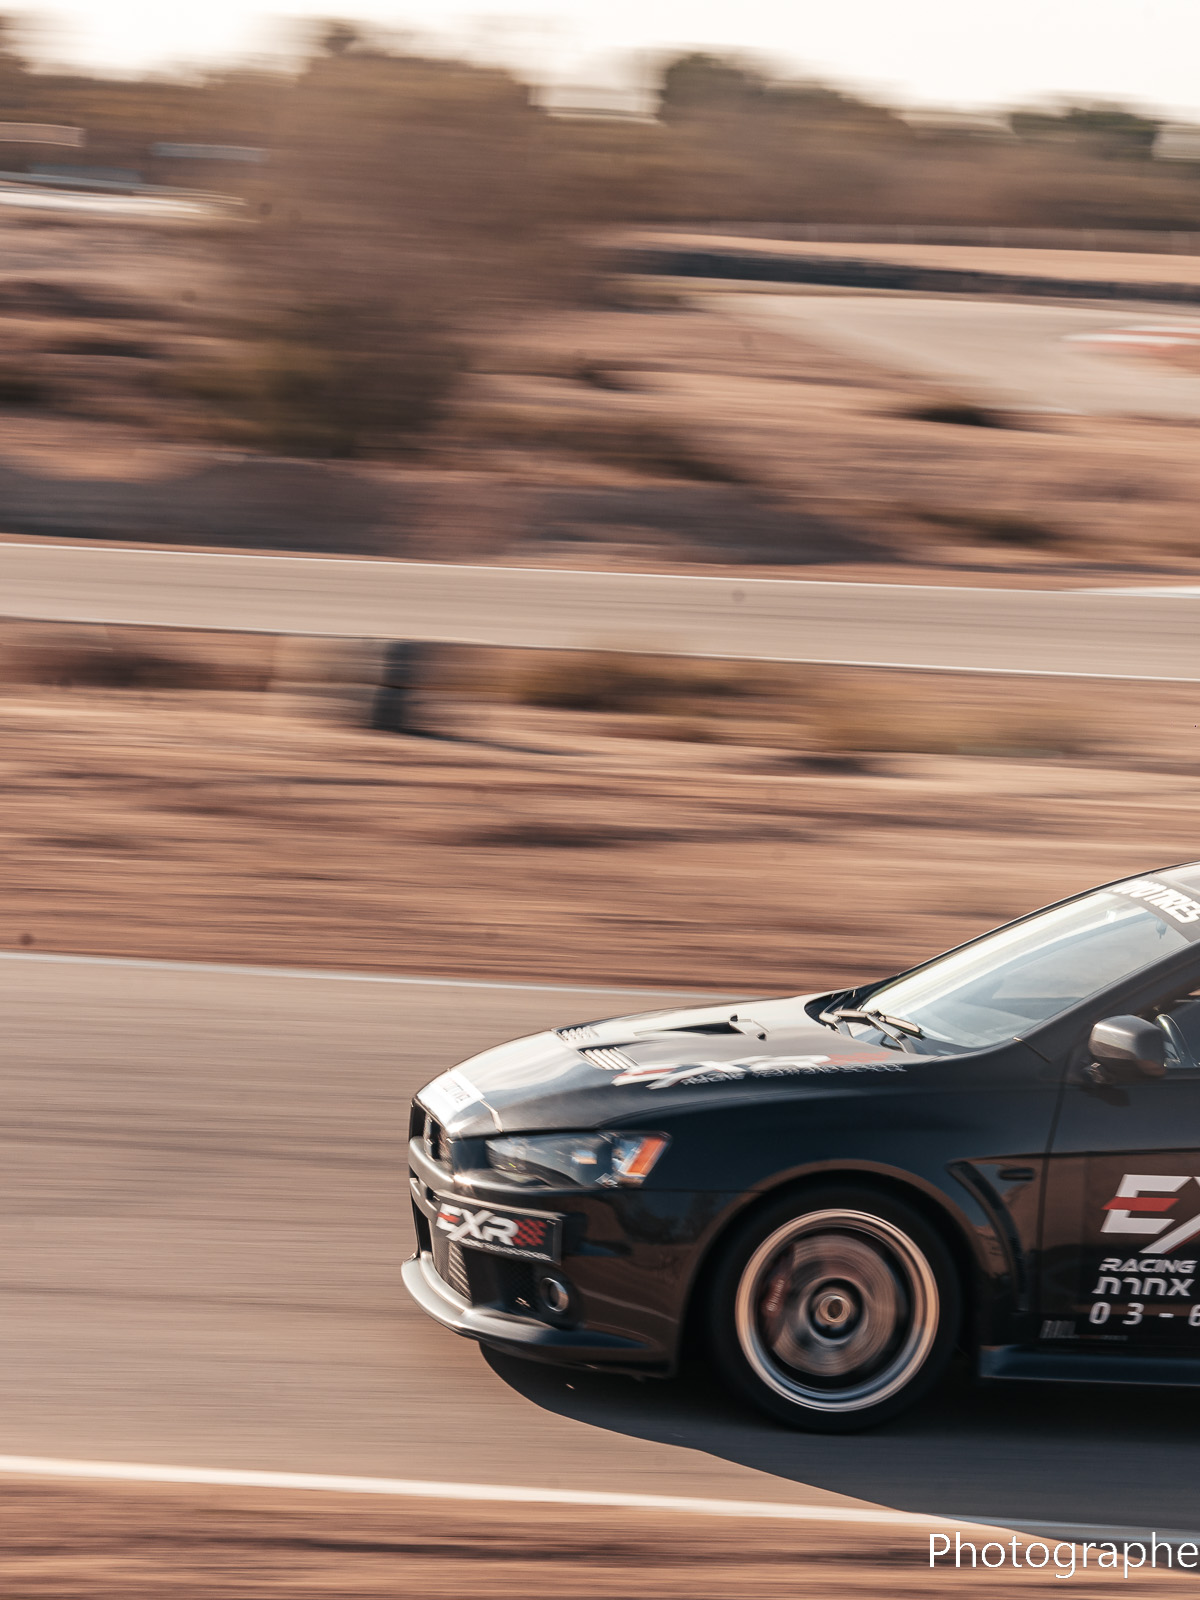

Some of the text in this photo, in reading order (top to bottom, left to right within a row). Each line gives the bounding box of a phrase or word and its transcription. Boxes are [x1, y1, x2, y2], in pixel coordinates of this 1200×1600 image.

[436, 1203, 519, 1247] EXR
[1099, 1257, 1198, 1274] RACING
[1091, 1276, 1196, 1297] אחרת
